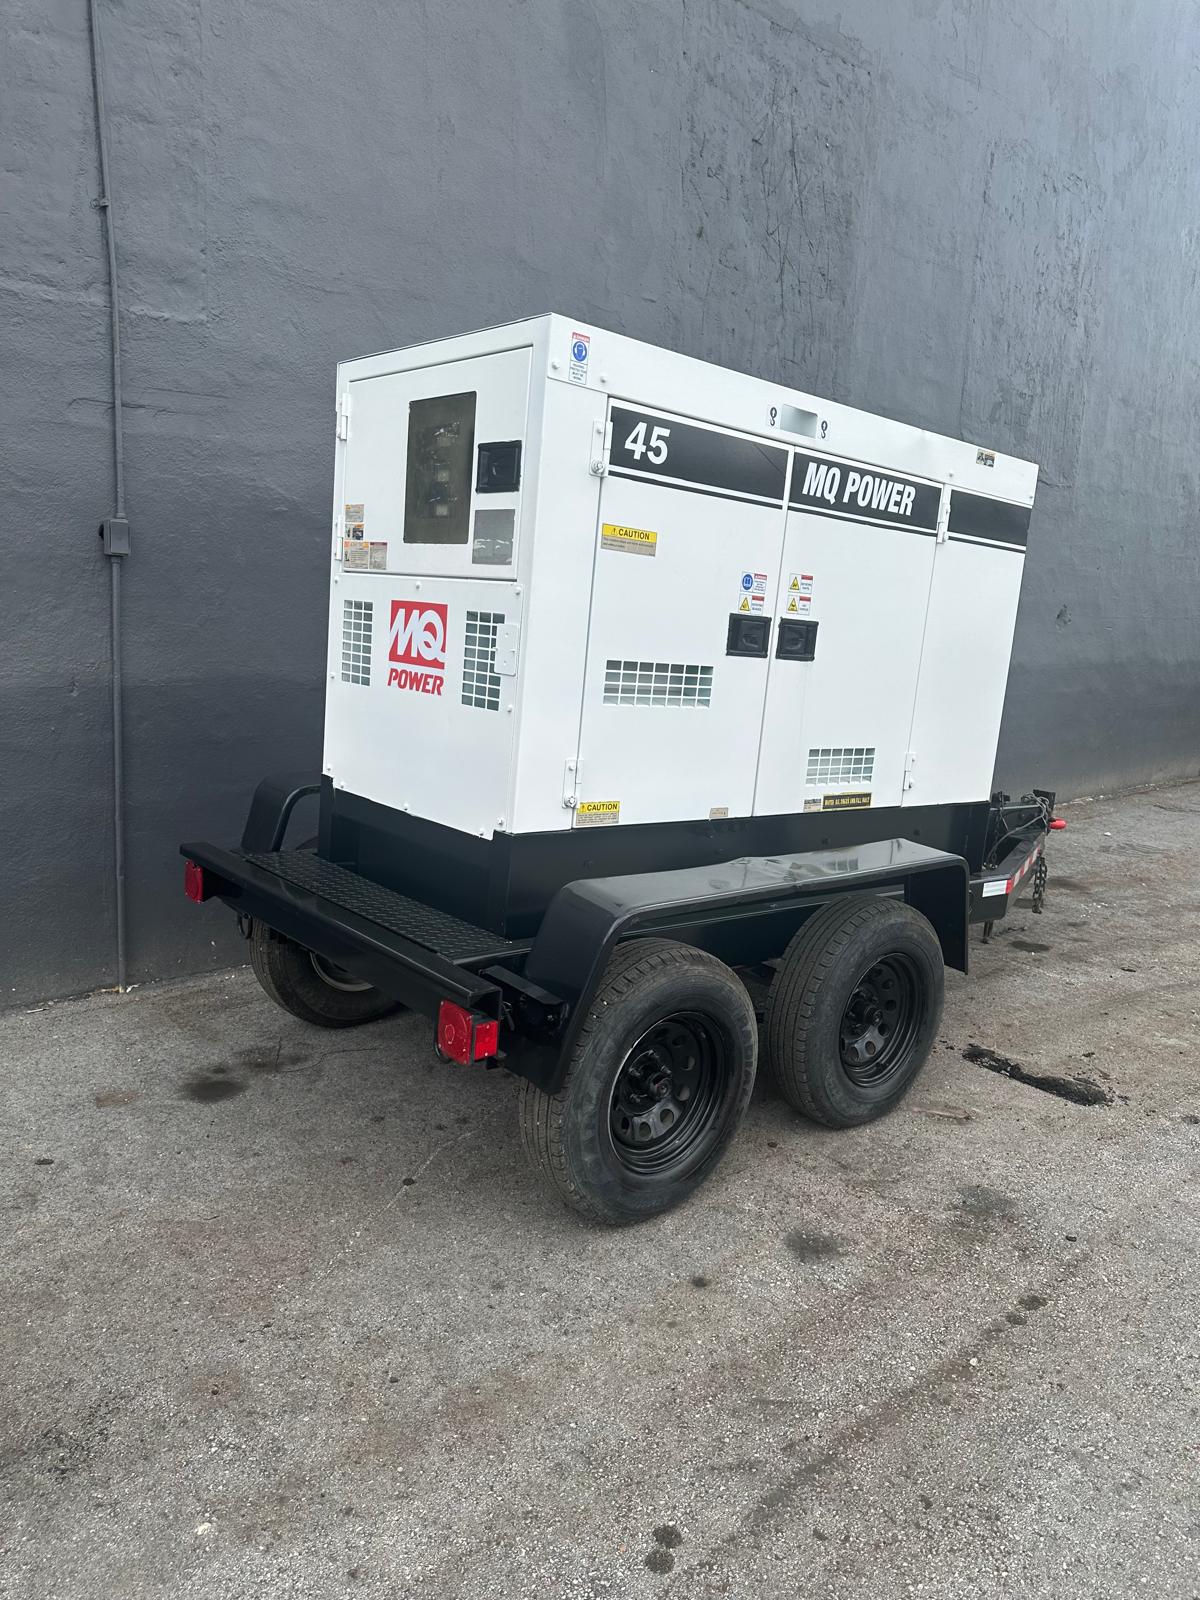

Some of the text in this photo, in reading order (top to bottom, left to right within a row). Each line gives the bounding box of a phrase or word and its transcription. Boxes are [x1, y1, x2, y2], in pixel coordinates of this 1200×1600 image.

[624, 421, 670, 464] 45
[802, 461, 916, 516] MQ POWER
[618, 528, 650, 541] CAUTION
[388, 608, 447, 663] MQ
[387, 667, 444, 696] POWER
[586, 803, 618, 812] CAUTION
